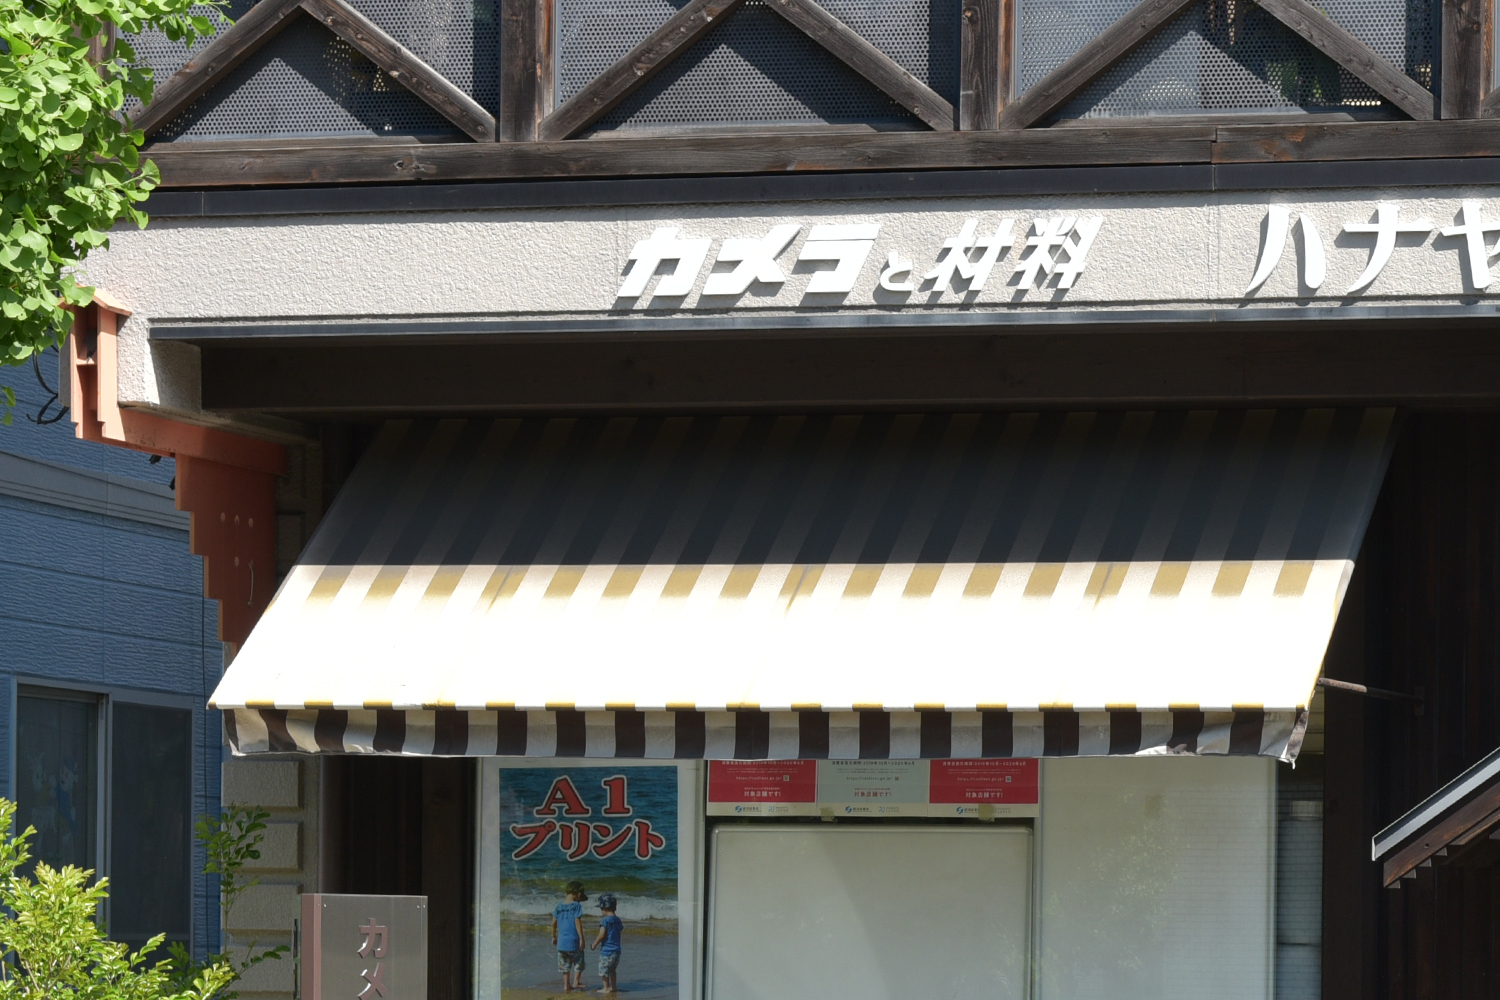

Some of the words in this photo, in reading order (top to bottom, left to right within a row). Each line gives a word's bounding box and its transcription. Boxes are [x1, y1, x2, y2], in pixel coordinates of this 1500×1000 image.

[618, 214, 1104, 299] カメラと材料
[534, 775, 633, 817] A1
[511, 818, 666, 863] プリント
